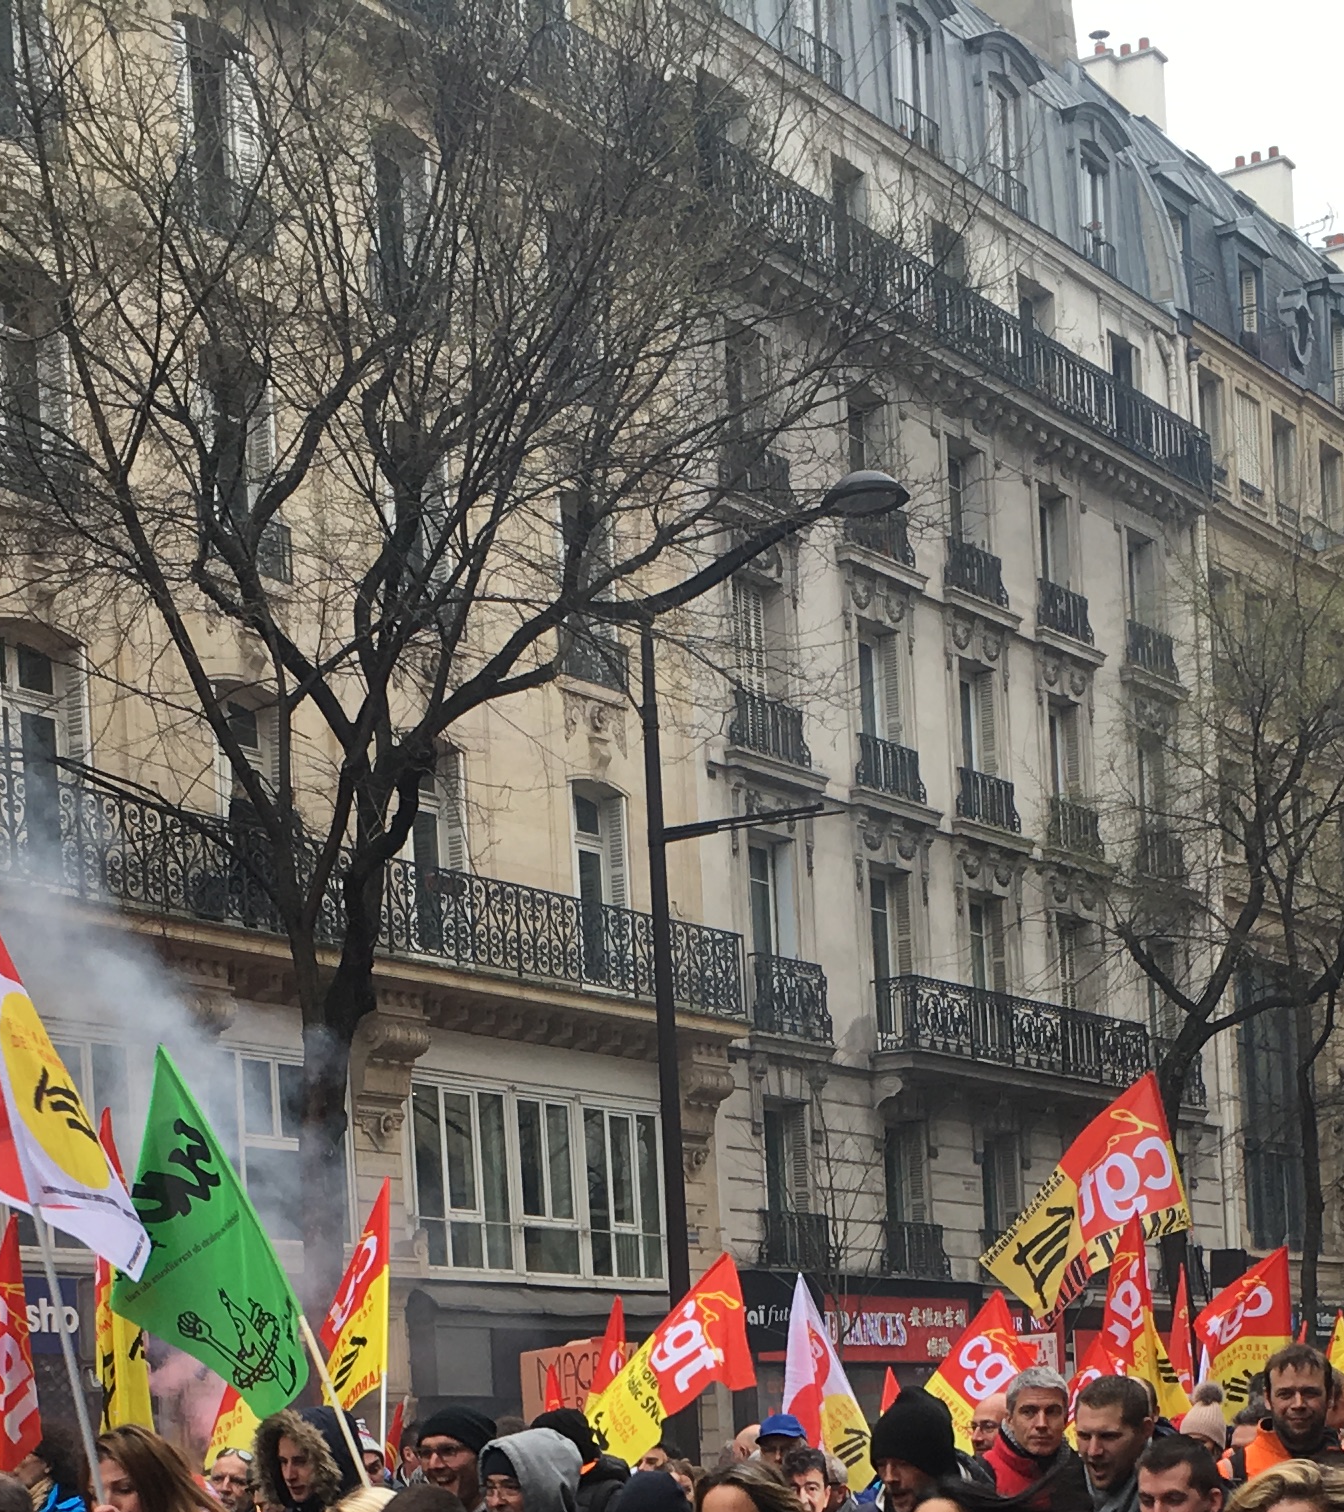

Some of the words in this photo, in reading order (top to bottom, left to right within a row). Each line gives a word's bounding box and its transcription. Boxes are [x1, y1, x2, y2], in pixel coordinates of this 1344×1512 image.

[26, 1297, 80, 1334] sho
[744, 1304, 765, 1326] aï
[824, 1311, 908, 1347] URANCES
[959, 1335, 1018, 1400] cg
